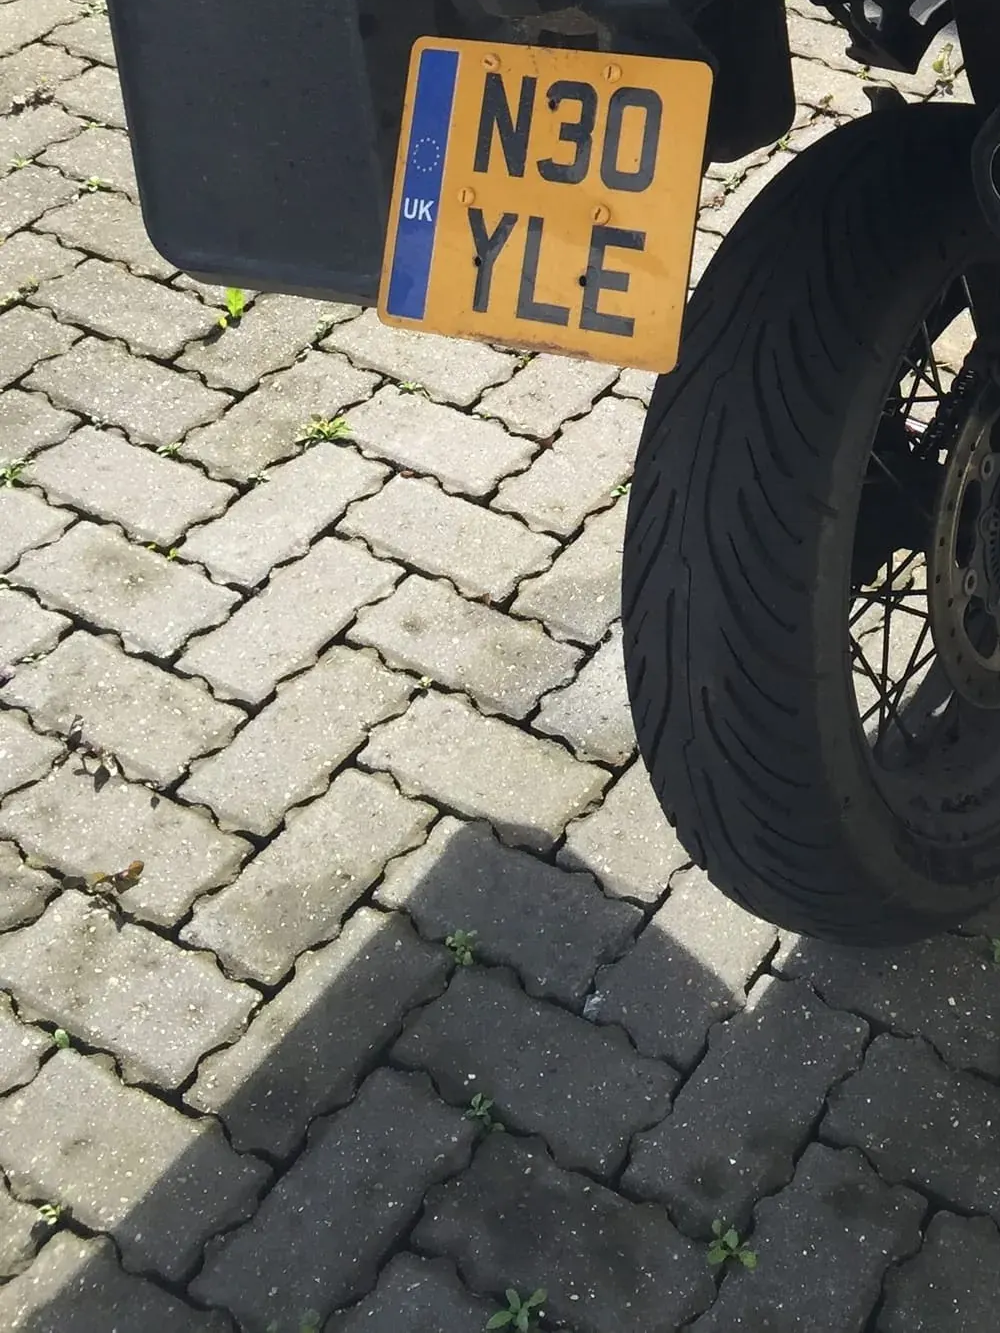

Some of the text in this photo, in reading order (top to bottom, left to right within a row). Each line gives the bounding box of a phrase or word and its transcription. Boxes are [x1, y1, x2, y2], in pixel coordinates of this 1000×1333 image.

[473, 72, 664, 193] N30
[403, 198, 434, 222] UK
[467, 207, 647, 338] YLE
